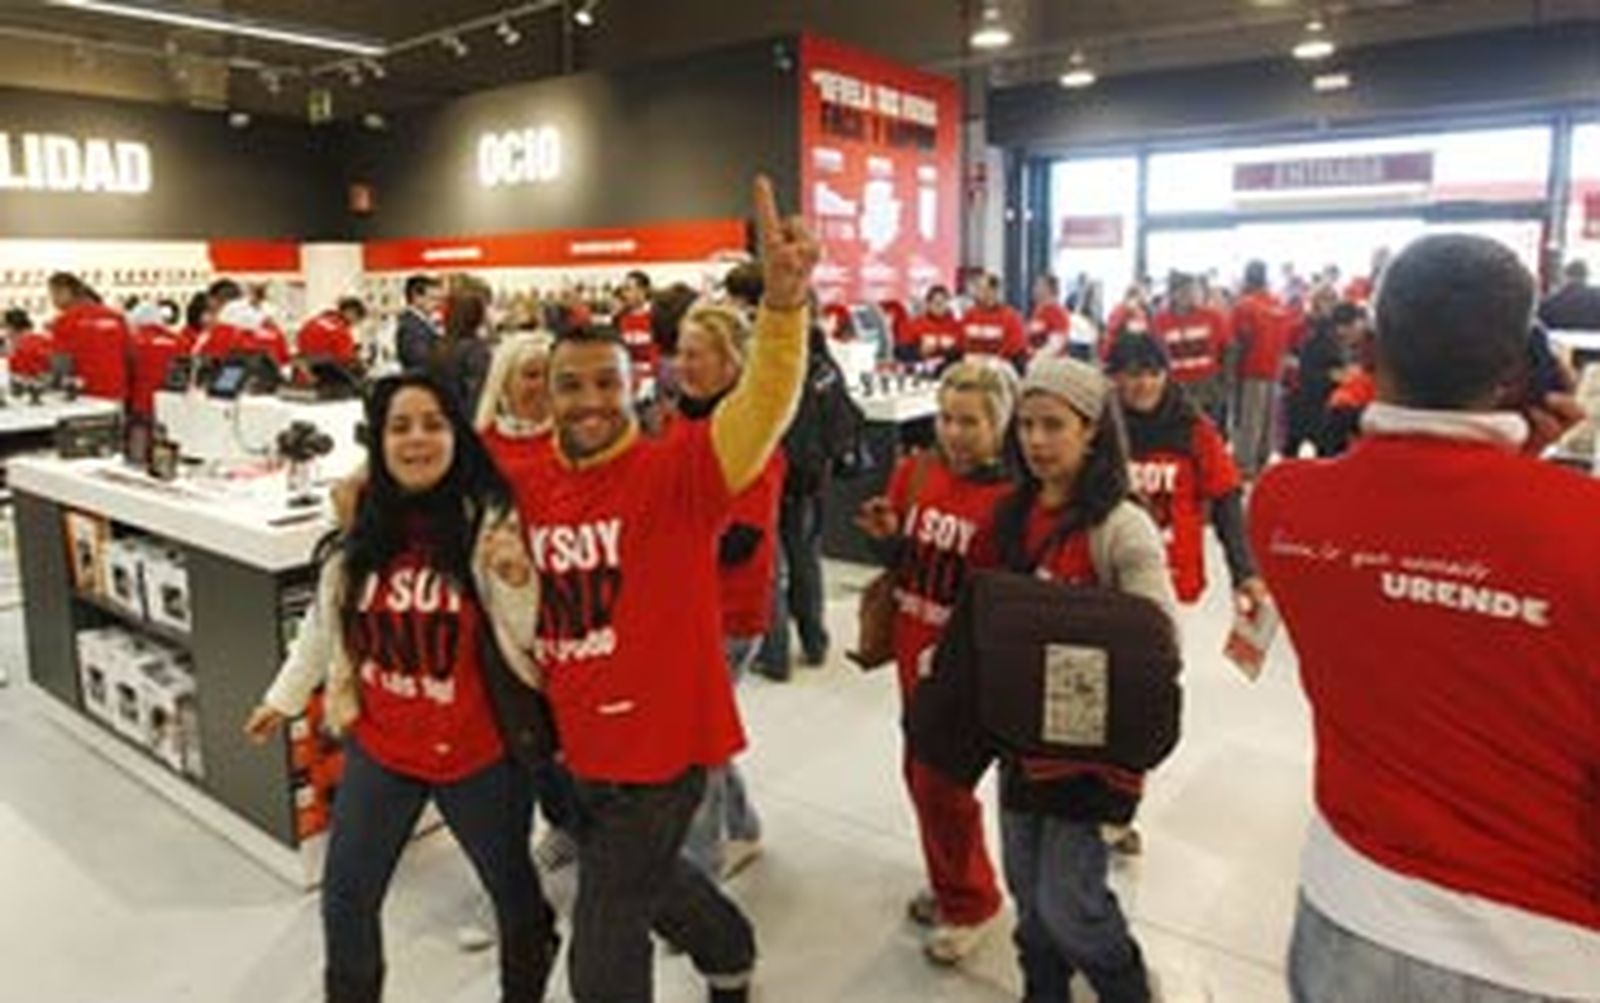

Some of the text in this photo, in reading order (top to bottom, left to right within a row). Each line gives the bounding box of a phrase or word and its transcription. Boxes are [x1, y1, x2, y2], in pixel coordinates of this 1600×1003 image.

[478, 125, 562, 187] OCIO
[918, 506, 977, 556] SOY
[1382, 571, 1550, 626] URENDE
